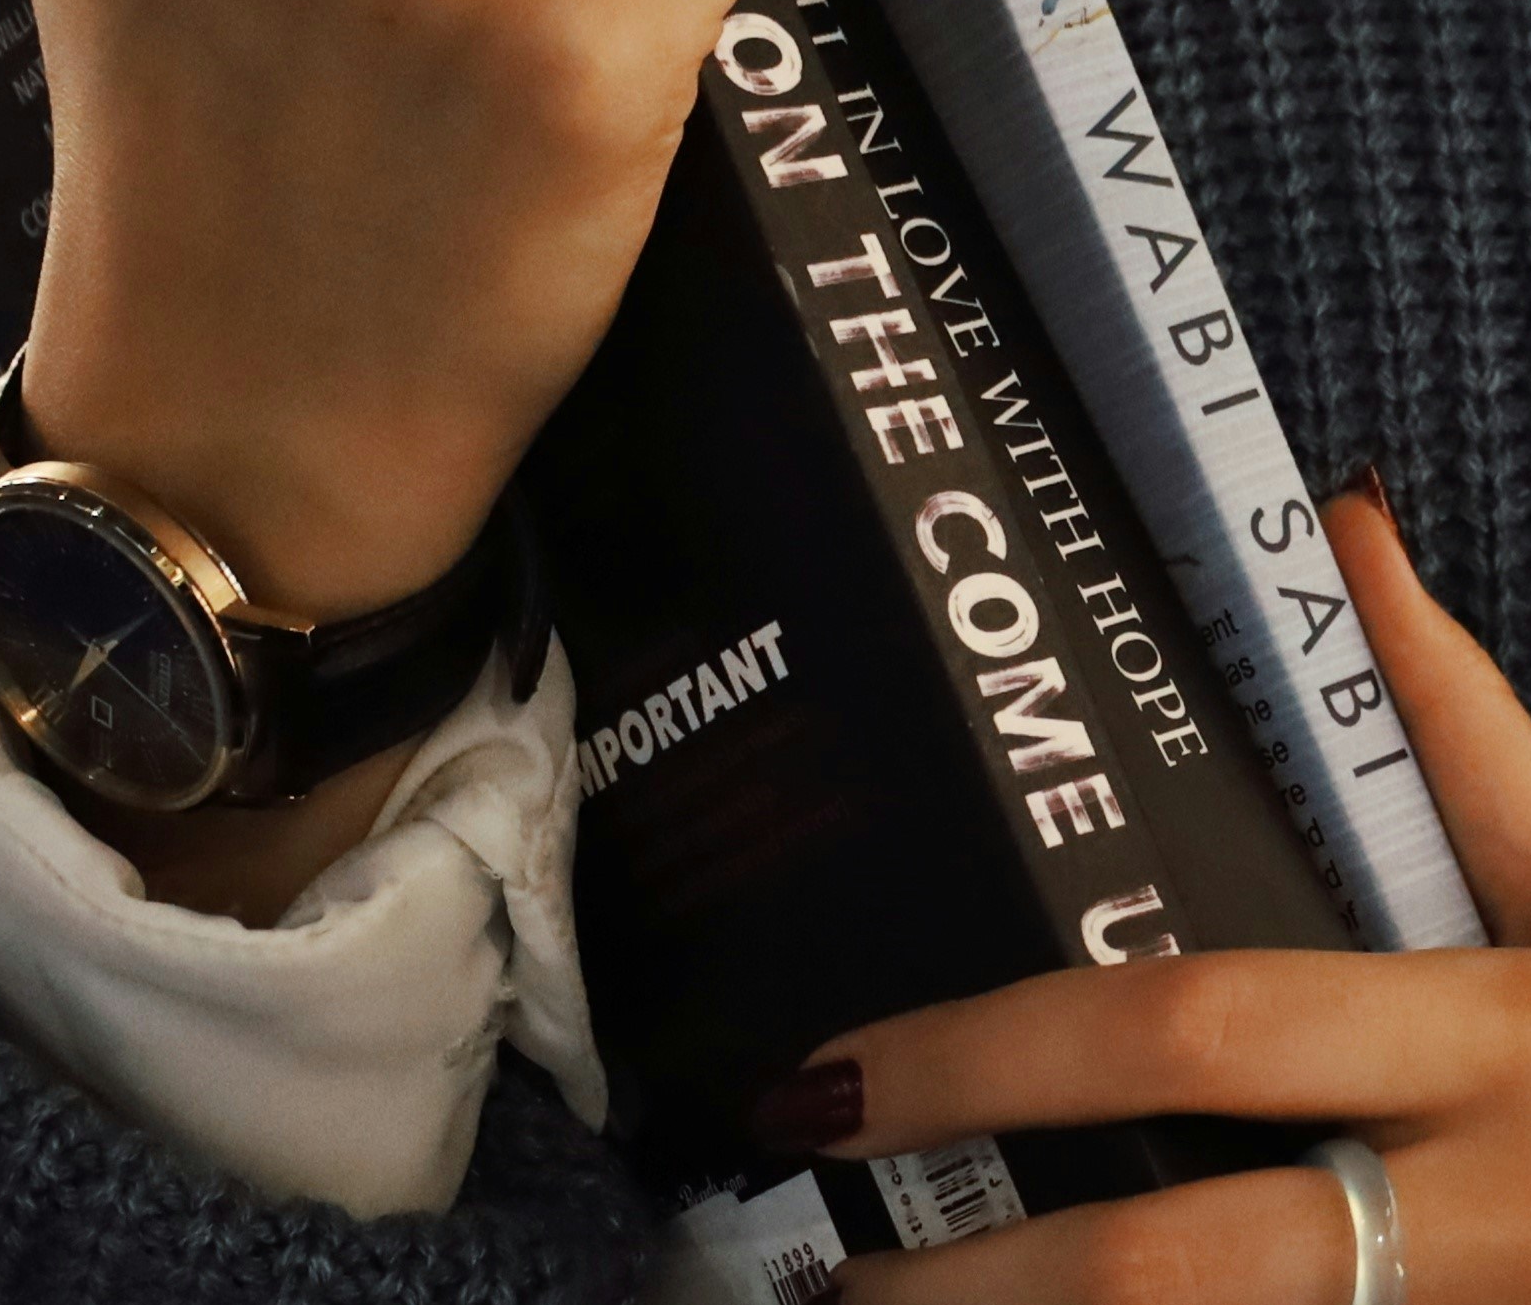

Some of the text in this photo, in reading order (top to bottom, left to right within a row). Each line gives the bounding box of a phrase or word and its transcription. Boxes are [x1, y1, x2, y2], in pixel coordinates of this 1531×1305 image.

[576, 618, 791, 799] MPORTANT
[712, 12, 1182, 968] ON THE COME U
[835, 83, 903, 162] IN
[875, 174, 1002, 359] LOVE
[979, 369, 1106, 561] WITH
[1076, 573, 1210, 769] HOPE
[1084, 86, 1410, 780] WABI SABI
